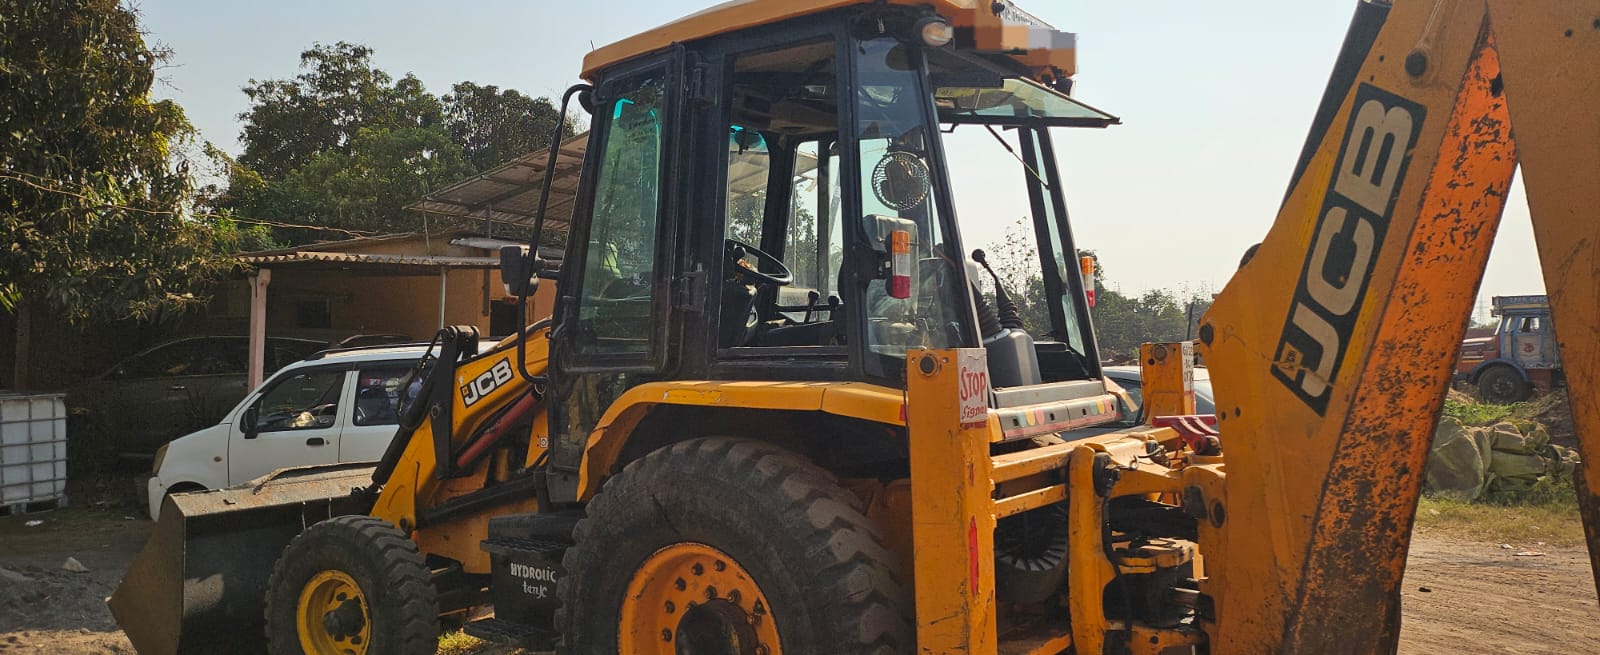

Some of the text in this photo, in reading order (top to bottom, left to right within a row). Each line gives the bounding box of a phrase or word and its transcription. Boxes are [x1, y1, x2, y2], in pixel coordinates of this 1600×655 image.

[1289, 99, 1414, 398] JCB
[463, 360, 513, 405] JCB
[960, 366, 987, 402] STOP
